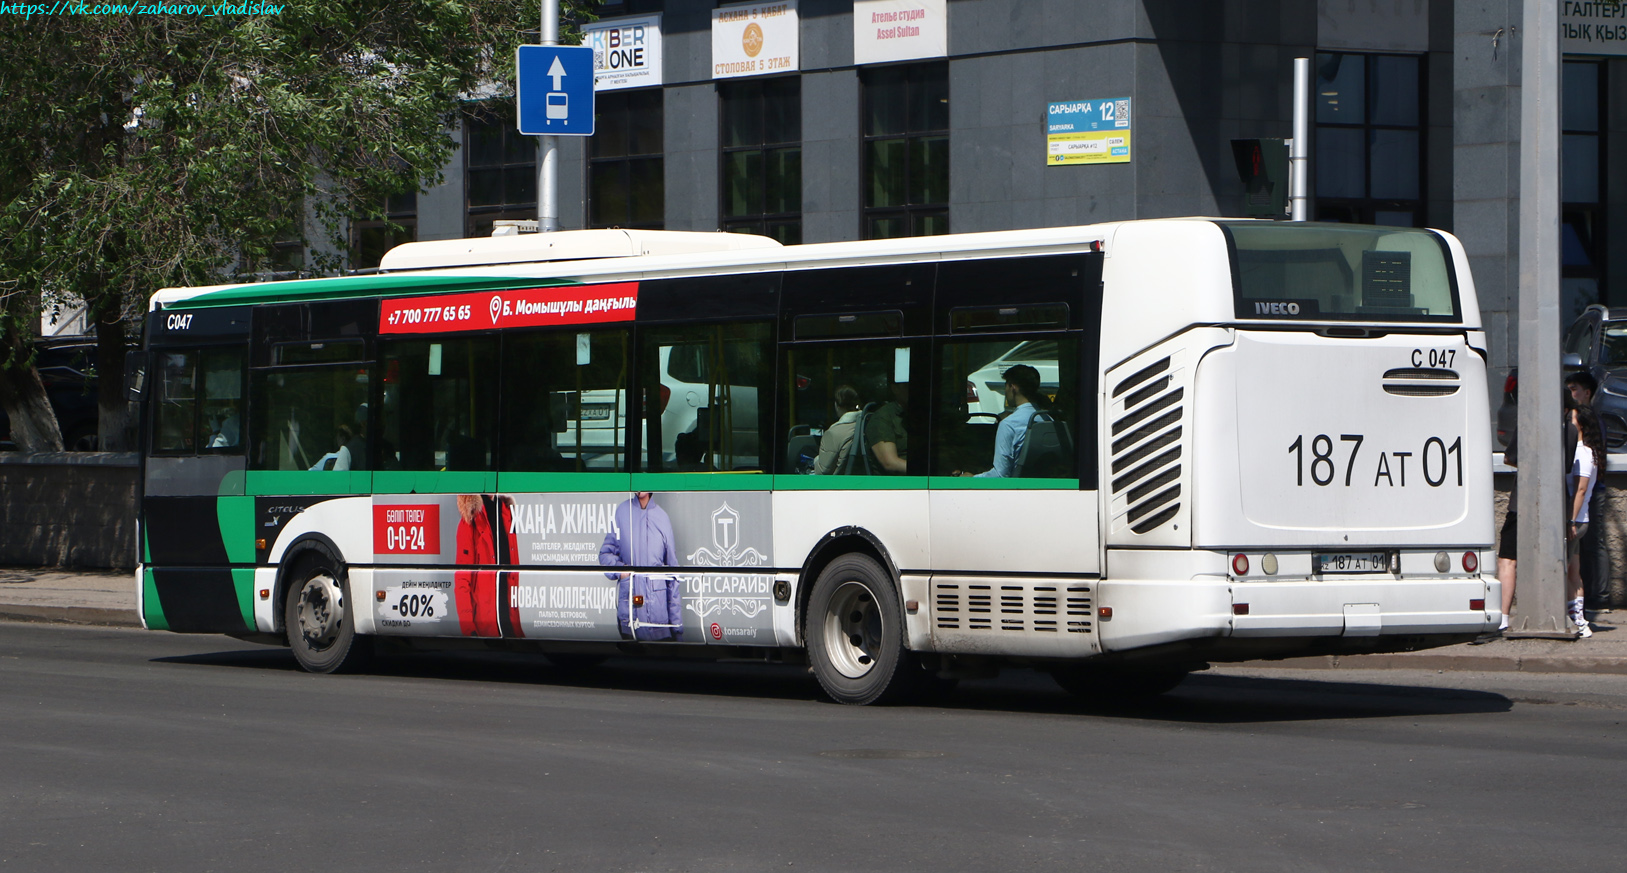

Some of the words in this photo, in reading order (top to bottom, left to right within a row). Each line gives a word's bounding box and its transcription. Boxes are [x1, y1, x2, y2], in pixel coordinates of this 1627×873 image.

[719, 10, 749, 23] АСХАНА
[752, 8, 757, 19] 5
[872, 12, 897, 23] Ателье
[899, 9, 924, 21] студия
[877, 27, 896, 40] Assel
[897, 26, 919, 38] Sultan
[610, 48, 643, 69] ONE
[715, 61, 755, 74] СТОЛОВАЯ
[760, 60, 764, 70] 5
[768, 56, 790, 69] ЭТАЖ
[1049, 103, 1092, 115] САРЫАРҚА
[1100, 101, 1114, 121] 12
[1049, 123, 1074, 131] SARYARKA
[388, 310, 401, 325] +7
[402, 309, 421, 324] 700
[423, 307, 442, 323] 777
[443, 306, 456, 321] 65
[458, 305, 471, 320] 65
[502, 300, 513, 316] Б.
[515, 299, 583, 316] Момышұлы
[1255, 302, 1300, 315] IVECO
[167, 314, 193, 330] C047
[1429, 348, 1456, 368] 047
[1288, 434, 1364, 487] 187
[1374, 452, 1413, 487] AT
[1422, 436, 1463, 487] 01
[510, 504, 557, 540] ЖАҢА
[561, 504, 620, 540] ЖИНАҚ
[387, 526, 425, 550] 0-0-24
[1332, 555, 1352, 569] 187
[1355, 558, 1367, 569] AT
[1372, 555, 1384, 569] 01
[685, 577, 711, 593] ТОН
[392, 594, 434, 617] -60%
[511, 586, 546, 608] НОВАЯ
[550, 586, 616, 614] КОЛЛЕКЦИЯ
[724, 626, 757, 638] tonsaraiy
